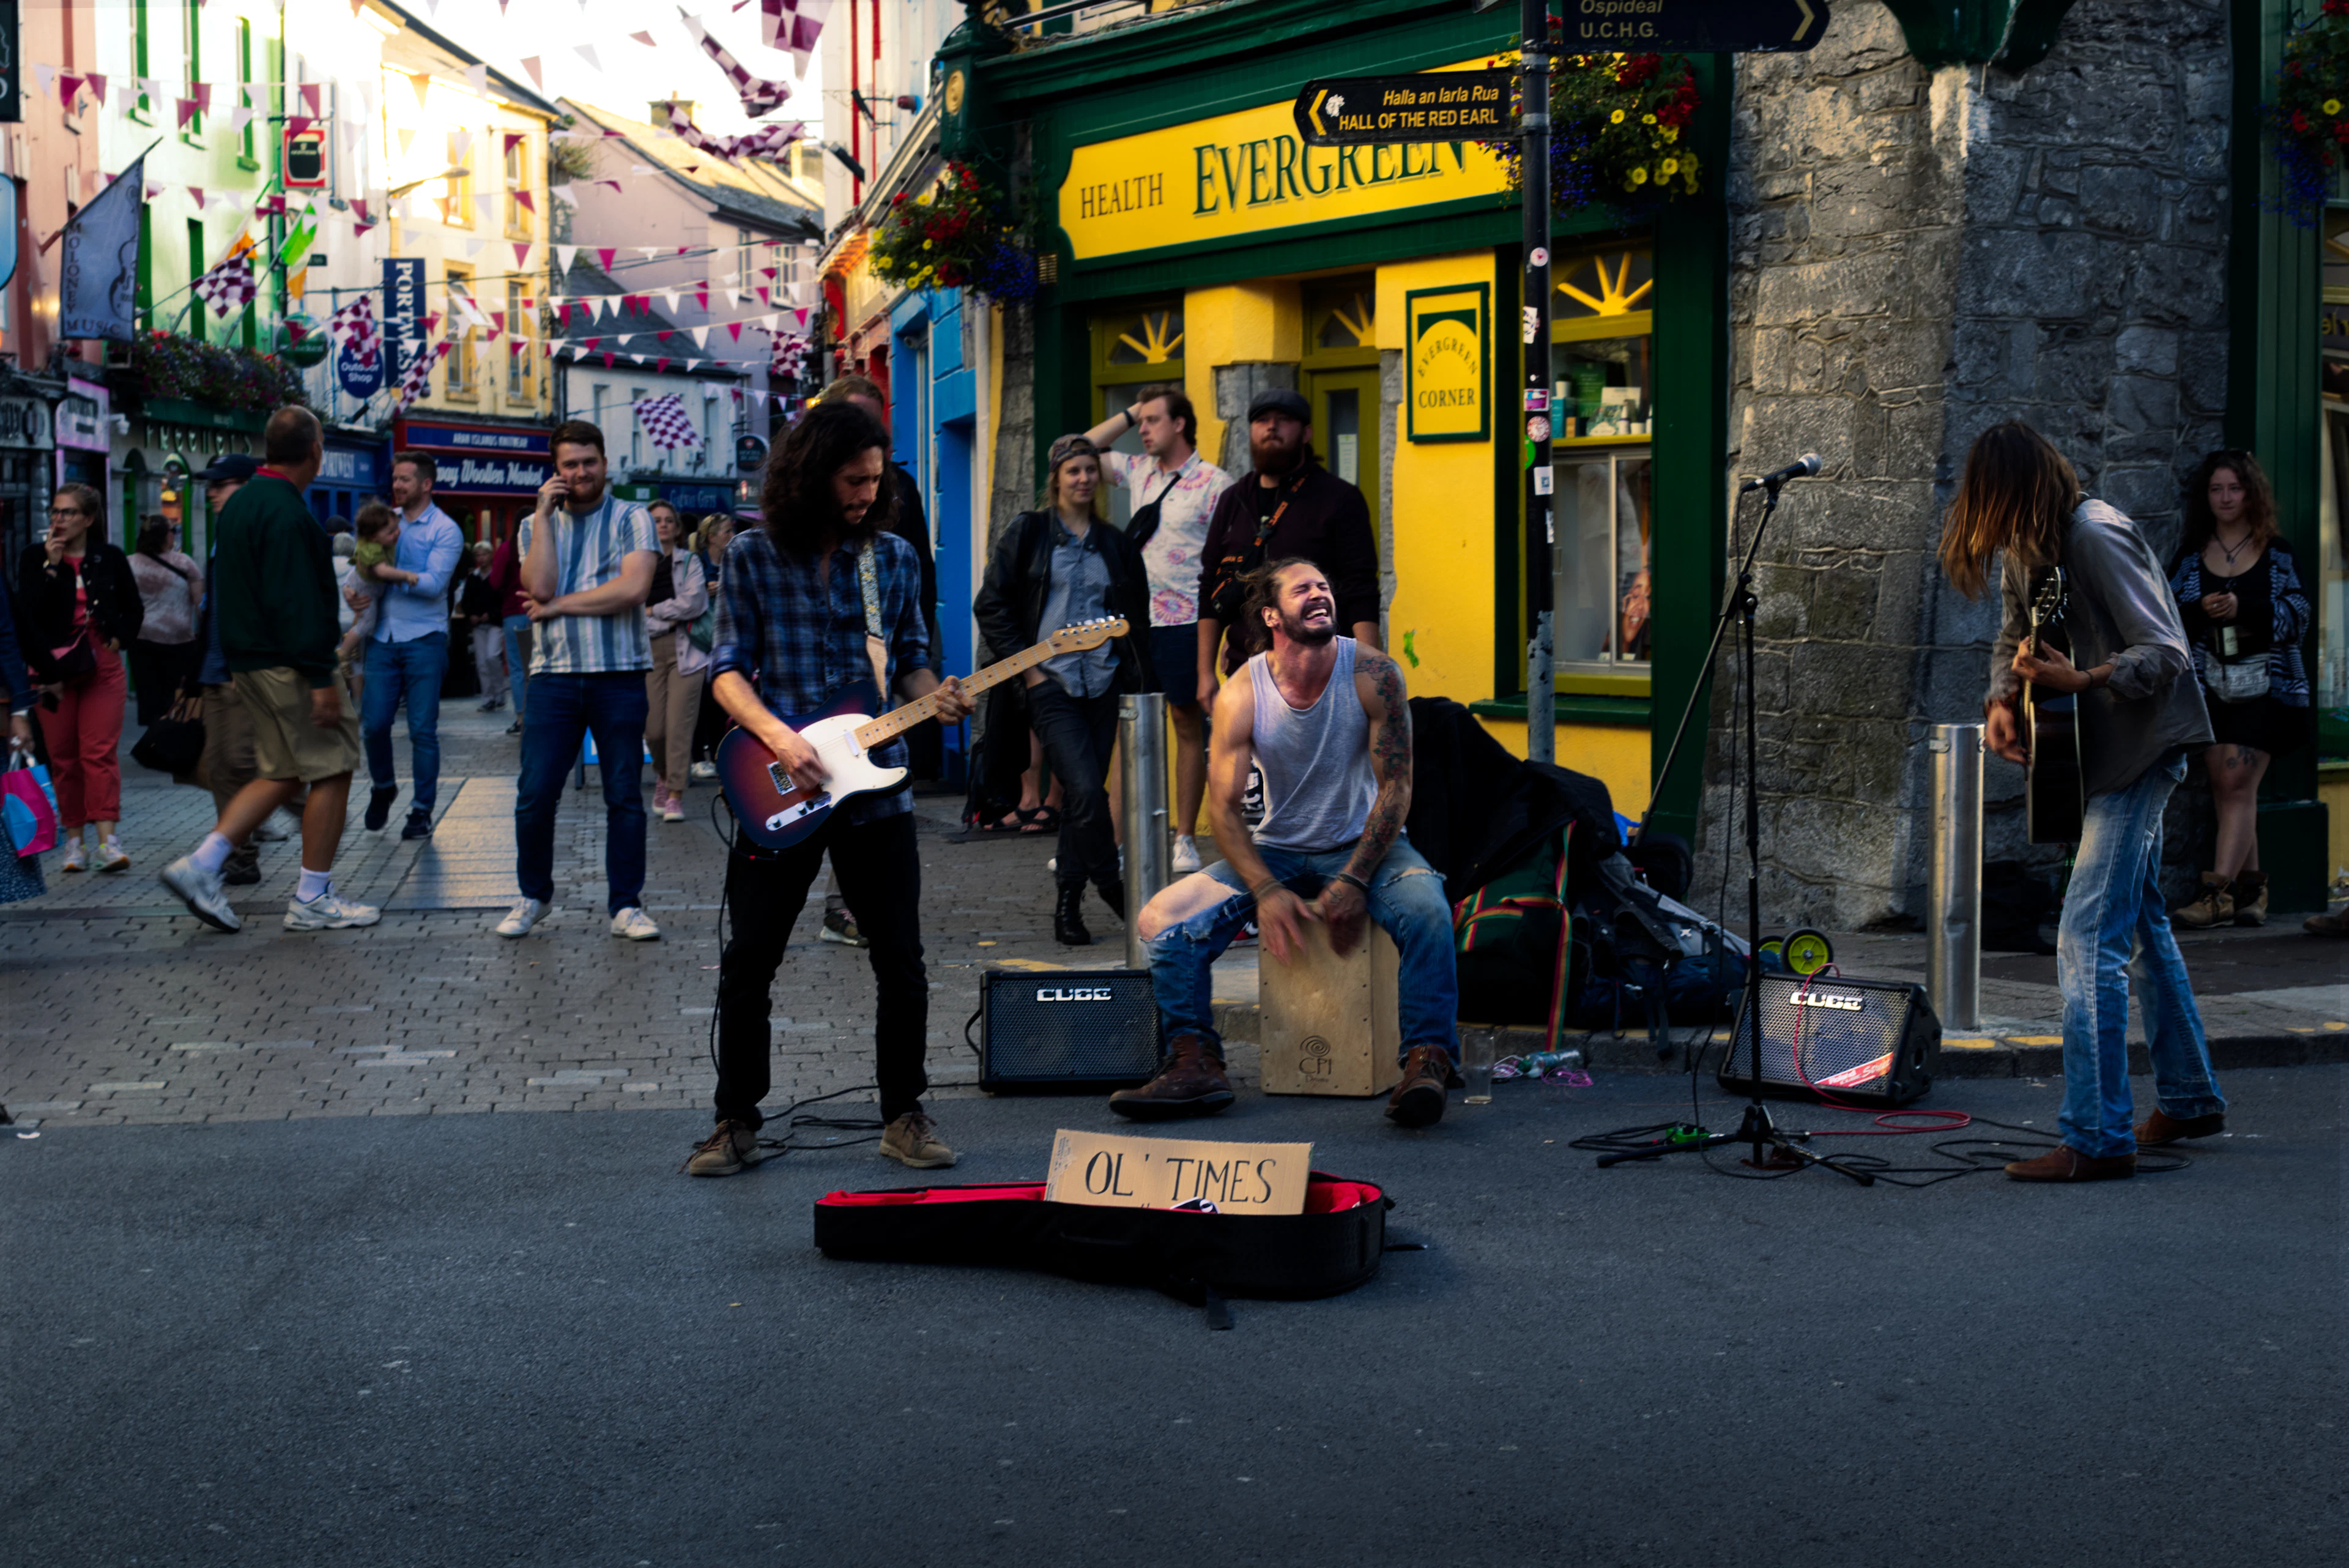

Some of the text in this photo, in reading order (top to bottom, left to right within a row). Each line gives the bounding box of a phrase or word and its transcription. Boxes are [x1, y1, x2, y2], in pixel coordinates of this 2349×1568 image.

[1580, 22, 1659, 38] U.C.H.G.
[1383, 85, 1499, 106] Halla an Iarla Rua
[1339, 108, 1499, 130] HALL OF THE RED EARL
[1080, 135, 1467, 219] HEALTH EVERGREEN
[66, 222, 81, 314] MOLONEY
[66, 319, 122, 335] MUSIC
[1417, 336, 1478, 378] EVERGREEN
[348, 373, 373, 384] Shop
[1419, 388, 1475, 408] CORNER
[461, 458, 505, 485] Woollen
[506, 461, 544, 486] Market
[1037, 988, 1111, 1001] CUBE
[1790, 992, 1863, 1011] CUBE
[1299, 1057, 1332, 1075] CPI
[1166, 1158, 1277, 1203] TIMES
